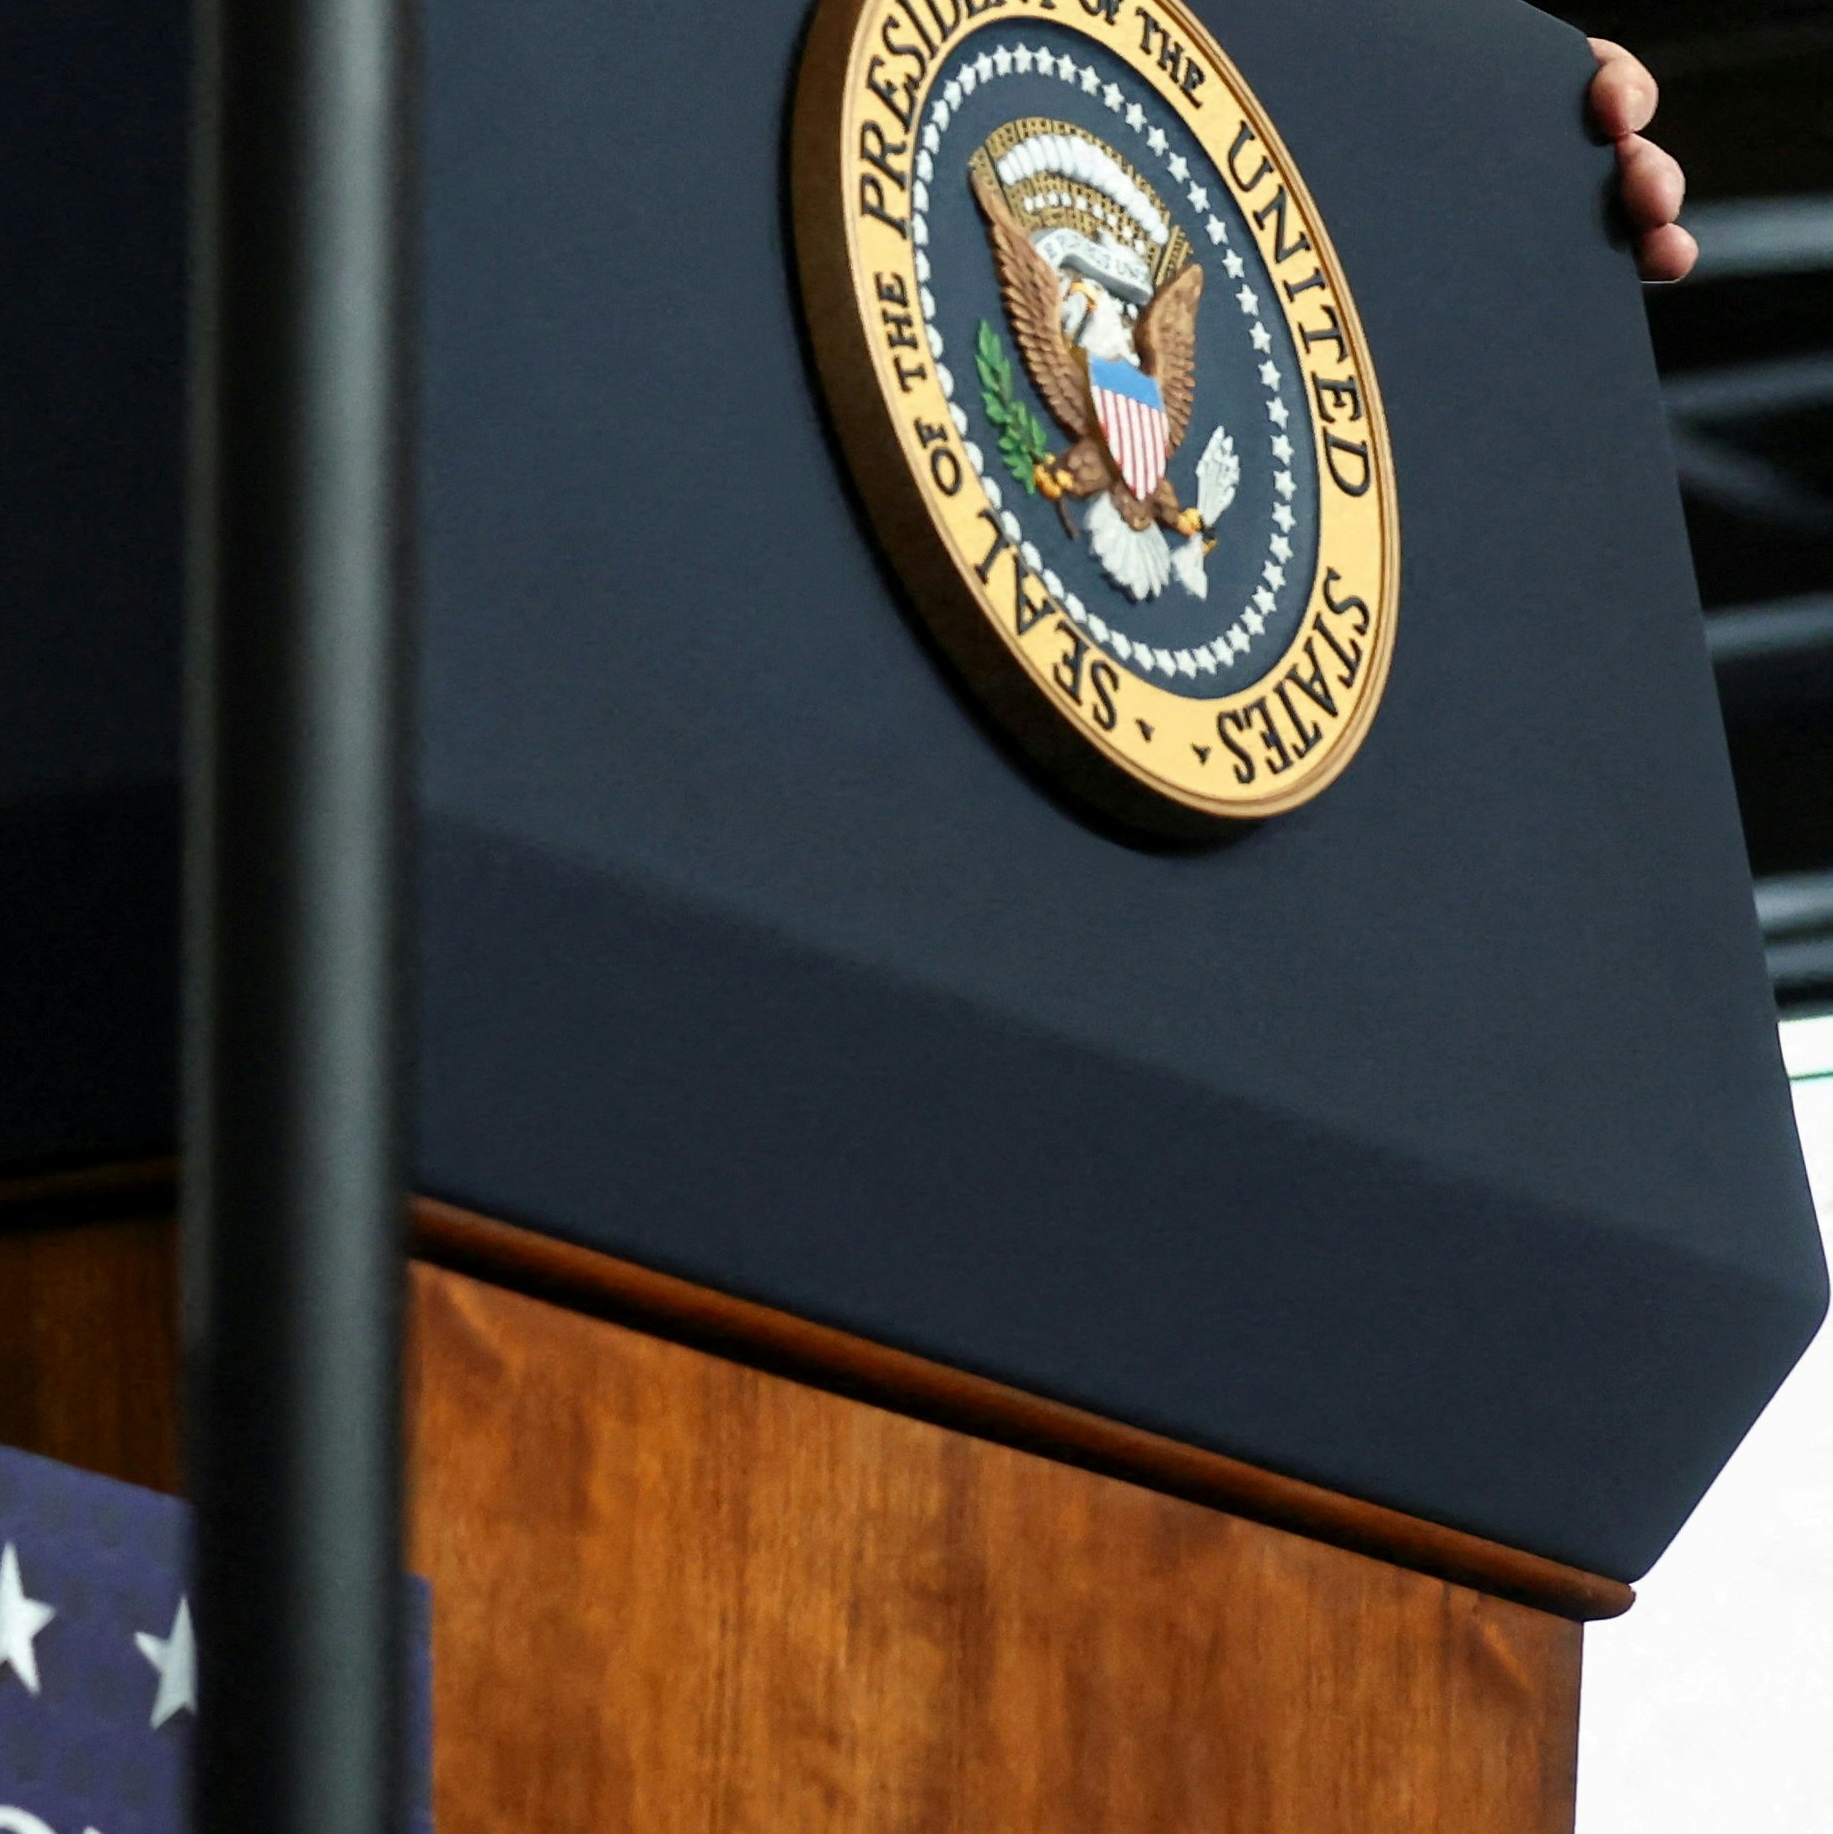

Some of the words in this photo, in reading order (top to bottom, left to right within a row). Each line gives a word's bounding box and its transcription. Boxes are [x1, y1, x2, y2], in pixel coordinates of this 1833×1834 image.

[1134, 6, 1207, 111] THE
[873, 269, 928, 393] THE
[1227, 119, 1371, 498] UNITED
[913, 416, 964, 497] OF
[973, 507, 1121, 731] SEAL
[1216, 565, 1371, 785] STATES
